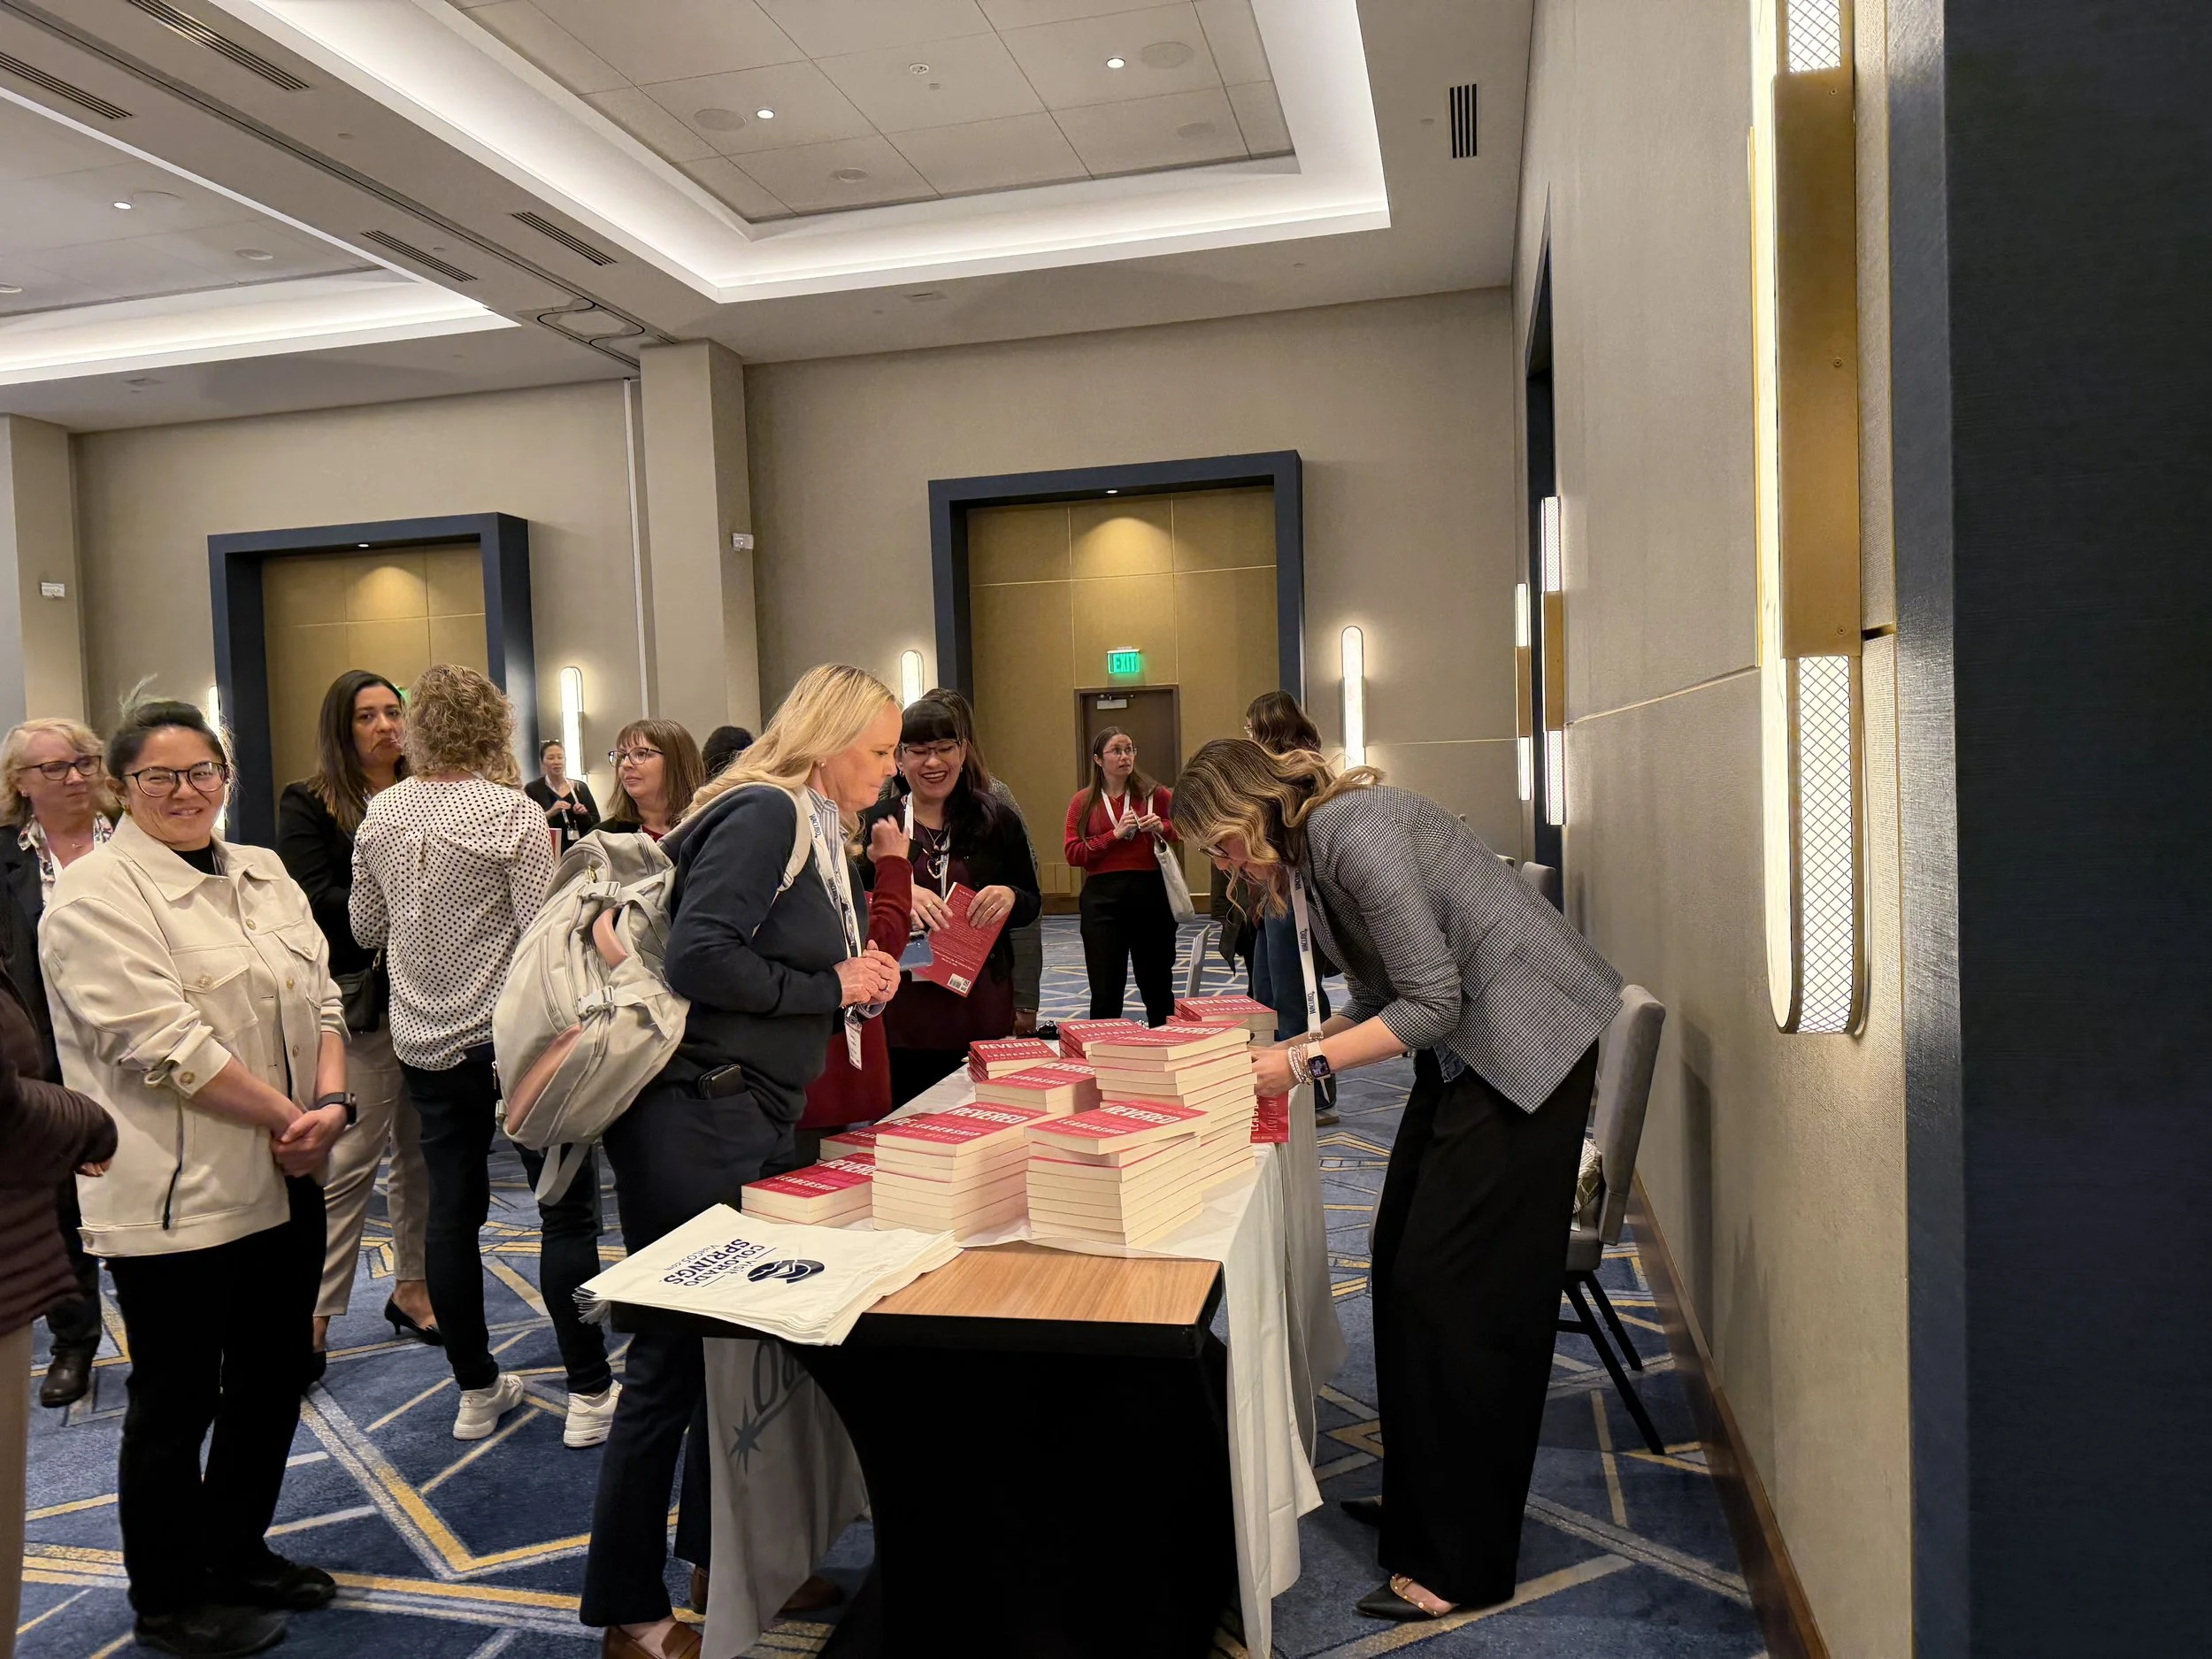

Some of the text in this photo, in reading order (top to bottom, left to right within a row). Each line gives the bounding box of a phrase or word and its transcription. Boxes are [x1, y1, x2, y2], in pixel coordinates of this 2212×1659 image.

[1113, 653, 1136, 672] EXIT
[1068, 1021, 1134, 1031] REVERED
[979, 1041, 1041, 1050] REVERED
[987, 1049, 1048, 1058] LEADERSHIP
[947, 1106, 1029, 1125] REVERED
[1100, 1105, 1182, 1125] REVERED
[908, 1122, 982, 1137] LEADERSHIP
[1056, 1118, 1128, 1135] LEADERSHIP
[774, 1175, 840, 1191] LEADERSHIP
[663, 1239, 750, 1285] SPRINGS
[683, 1245, 765, 1286] COLORADO
